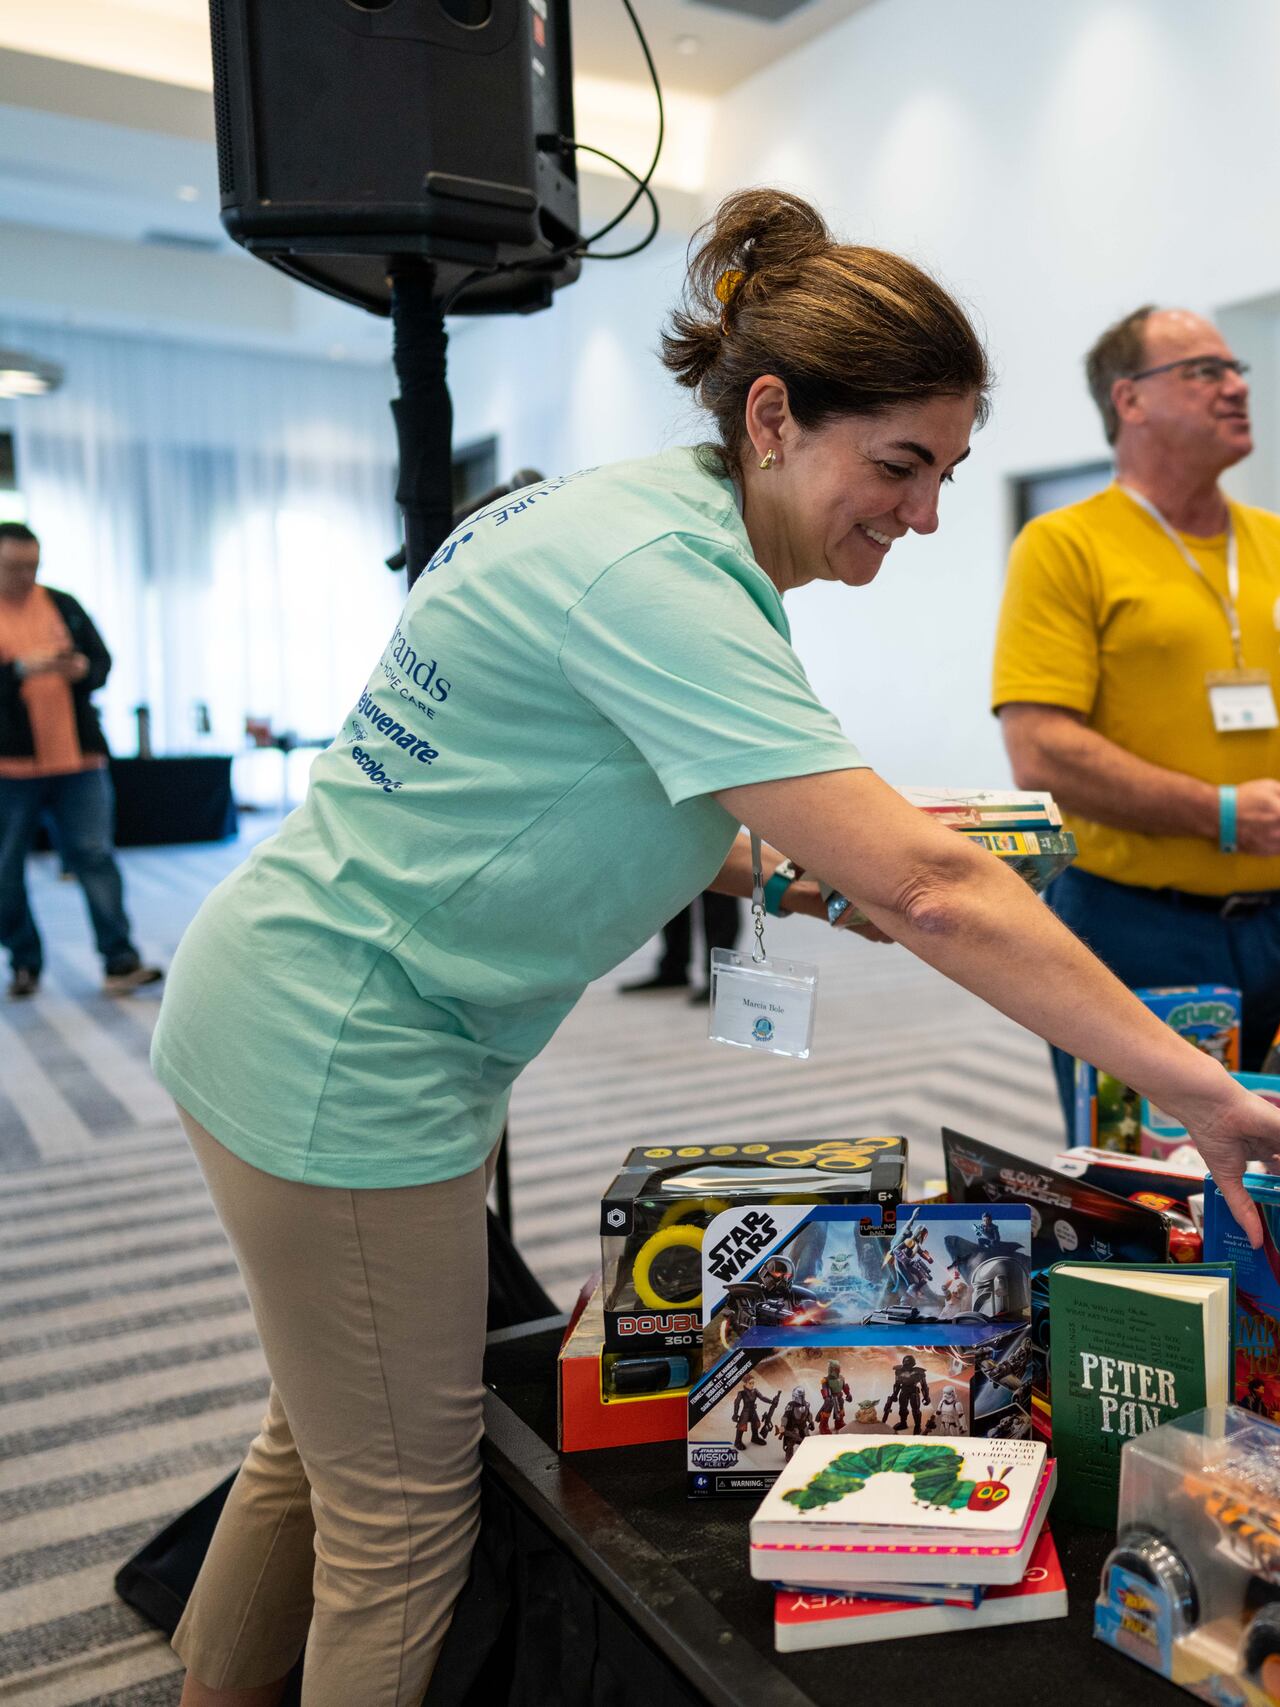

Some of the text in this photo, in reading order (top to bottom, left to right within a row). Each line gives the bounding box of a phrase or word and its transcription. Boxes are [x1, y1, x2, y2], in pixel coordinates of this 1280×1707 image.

[389, 627, 451, 702] rands
[400, 688, 436, 720] CARE
[358, 690, 439, 764] ejuvenate
[743, 998, 767, 1010] Marcia
[1000, 1168, 1040, 1185] GLOW
[878, 1192, 893, 1201] 6+
[1005, 1185, 1072, 1209] RACERS
[707, 1211, 770, 1275] STAR
[713, 1217, 778, 1283] WARS
[617, 1313, 703, 1336] DOUBL
[664, 1336, 692, 1345] 360
[1080, 1352, 1179, 1408] PETER
[1099, 1396, 1161, 1438] PAN
[693, 1453, 737, 1461] MISSION
[697, 1478, 708, 1486] 4+
